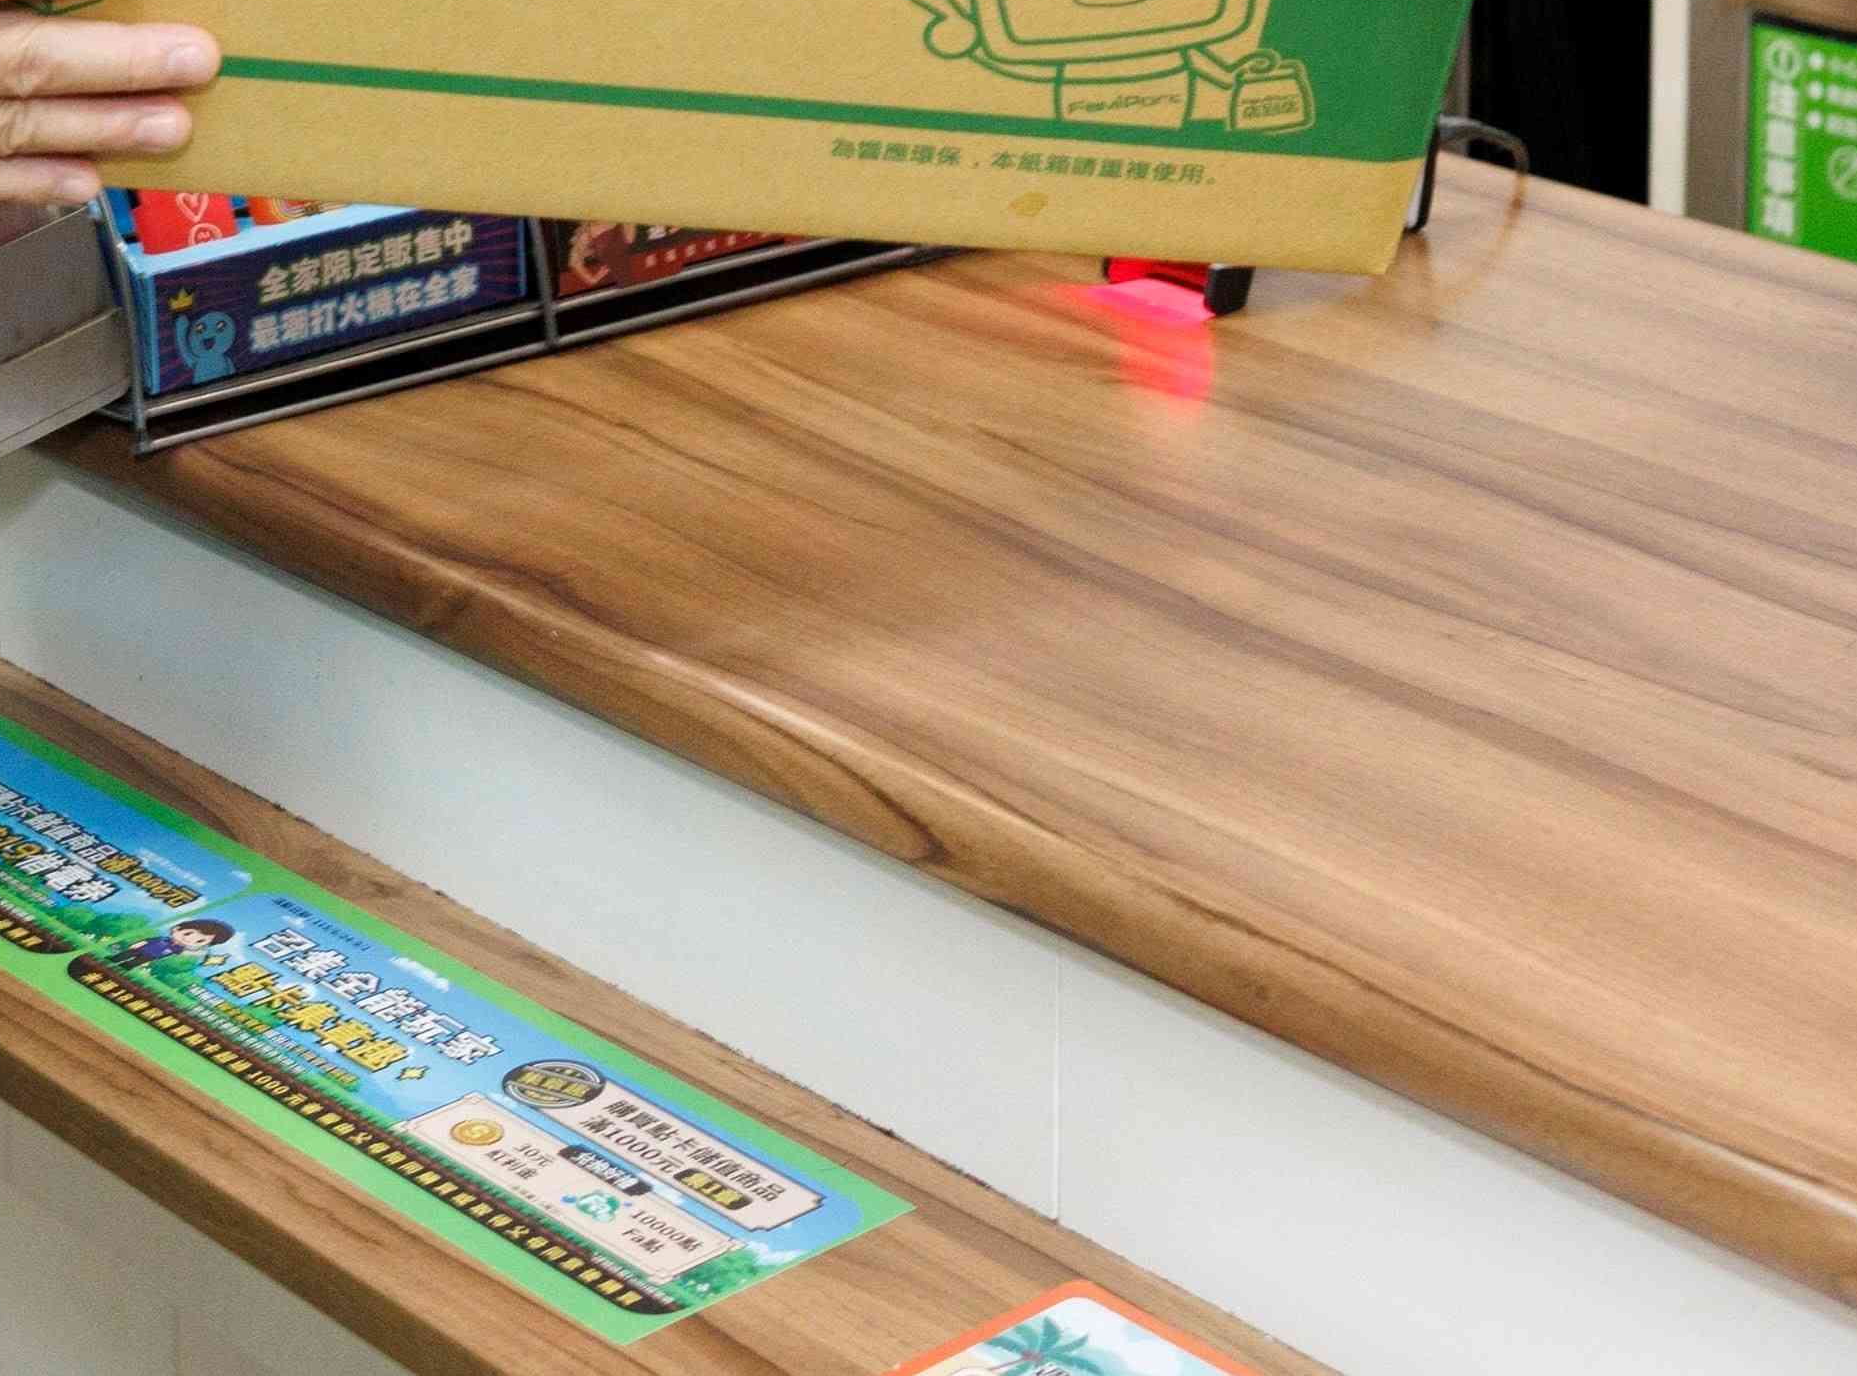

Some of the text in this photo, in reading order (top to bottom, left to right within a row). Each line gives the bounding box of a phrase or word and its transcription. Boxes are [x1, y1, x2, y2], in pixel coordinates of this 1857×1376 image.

[258, 219, 473, 304] 全家限定販售中
[252, 927, 506, 1065] 召集全能玩家
[577, 1115, 690, 1174] 滿1000元
[602, 1099, 788, 1202] 購買點卡儲值商品
